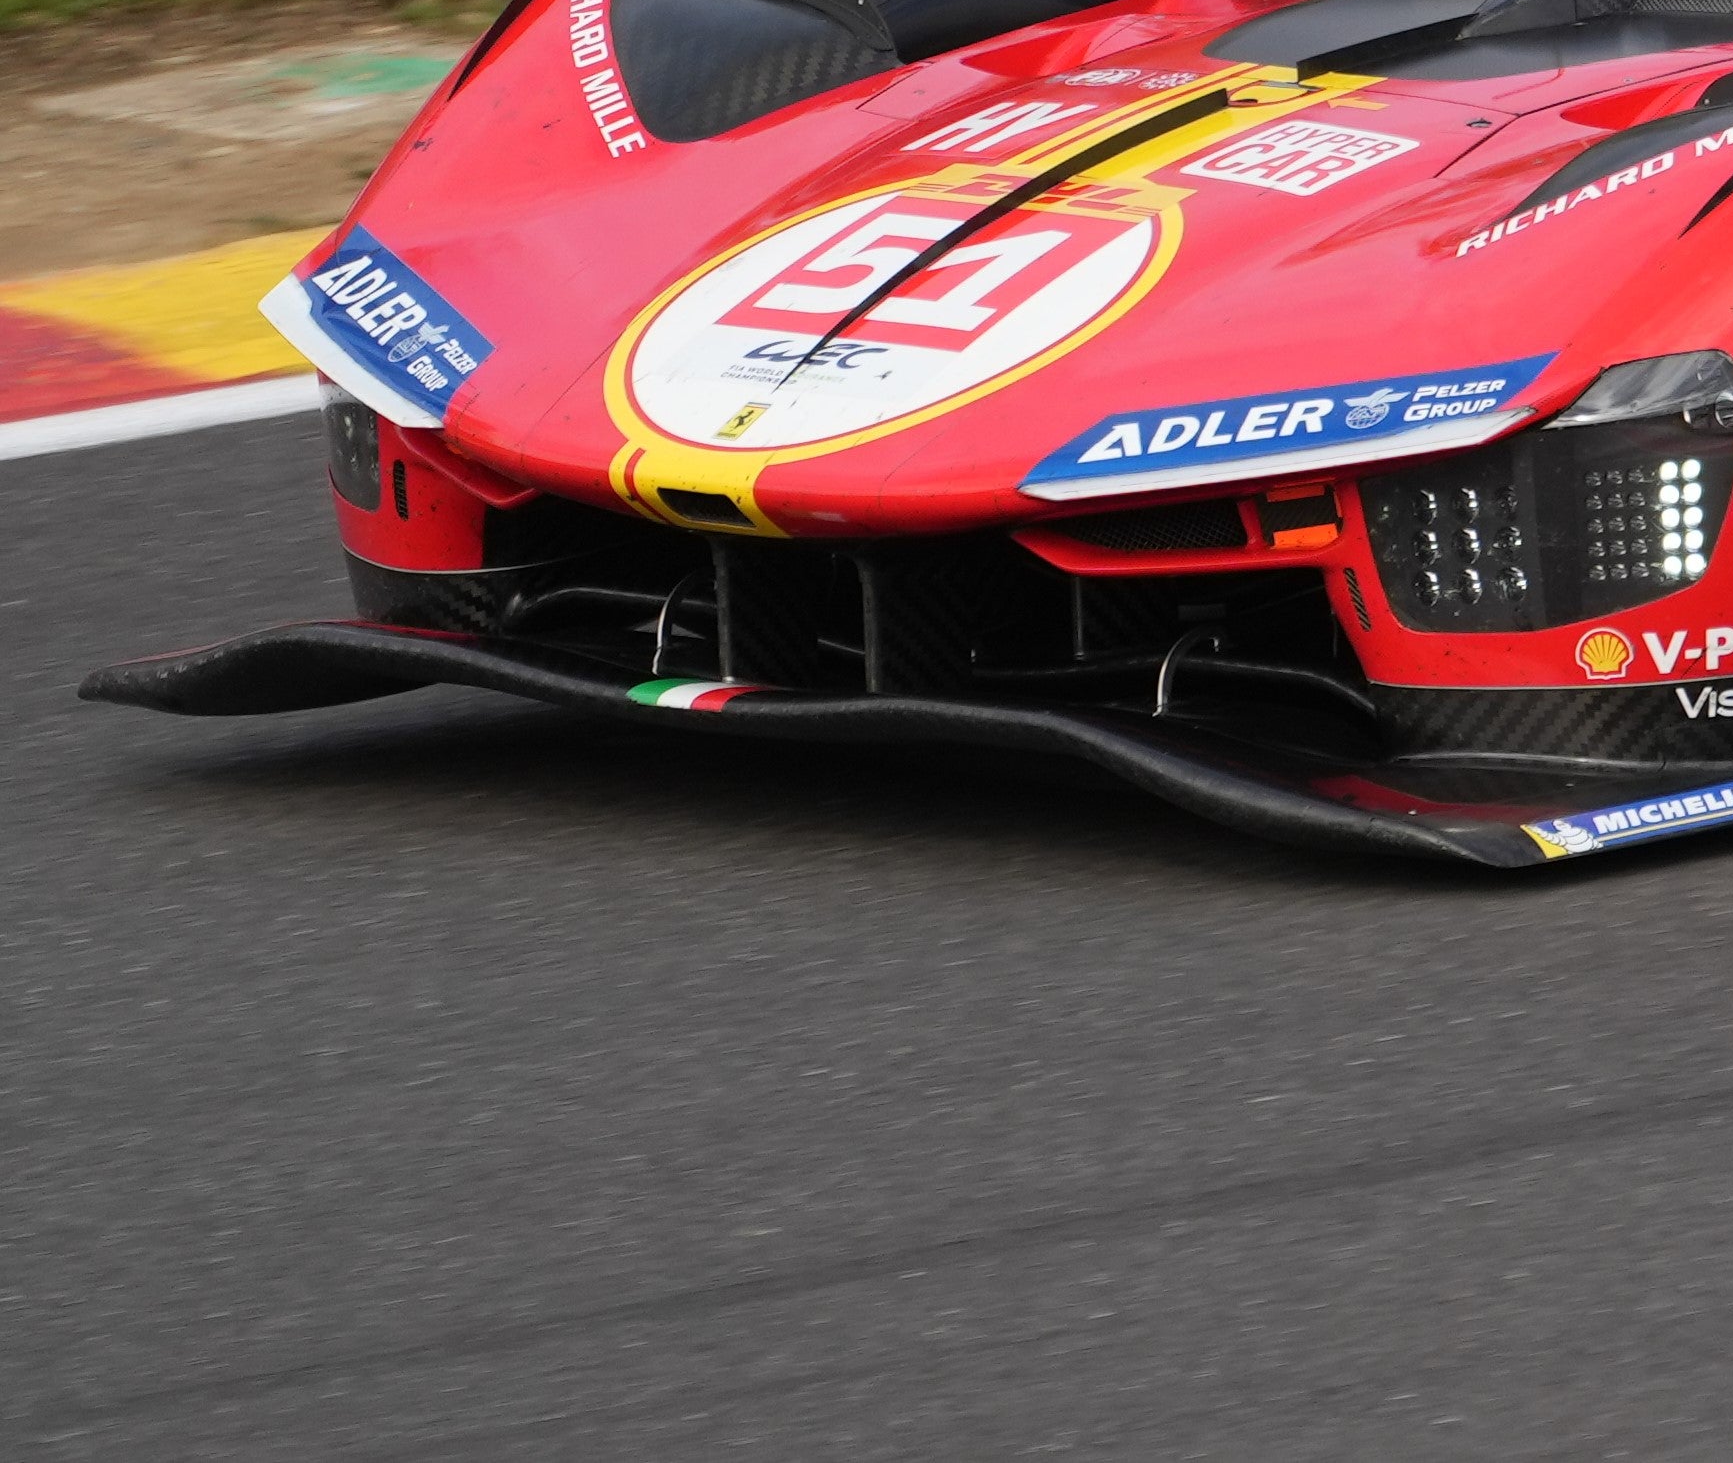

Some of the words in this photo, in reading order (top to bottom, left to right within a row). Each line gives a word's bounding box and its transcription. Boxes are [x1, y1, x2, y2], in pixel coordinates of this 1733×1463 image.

[579, 67, 646, 158] MILLE
[1203, 142, 1356, 189] CAR
[1260, 124, 1401, 160] HYPER
[1455, 151, 1675, 259] RICHARD
[752, 212, 1071, 331] 51
[312, 255, 428, 347] ADLER
[406, 355, 448, 391] GROUP
[434, 338, 478, 375] PELZER
[743, 340, 889, 369] WEC
[1077, 397, 1334, 464] ADLER
[1412, 379, 1507, 402] PELZER
[1403, 398, 1497, 422] GROUP
